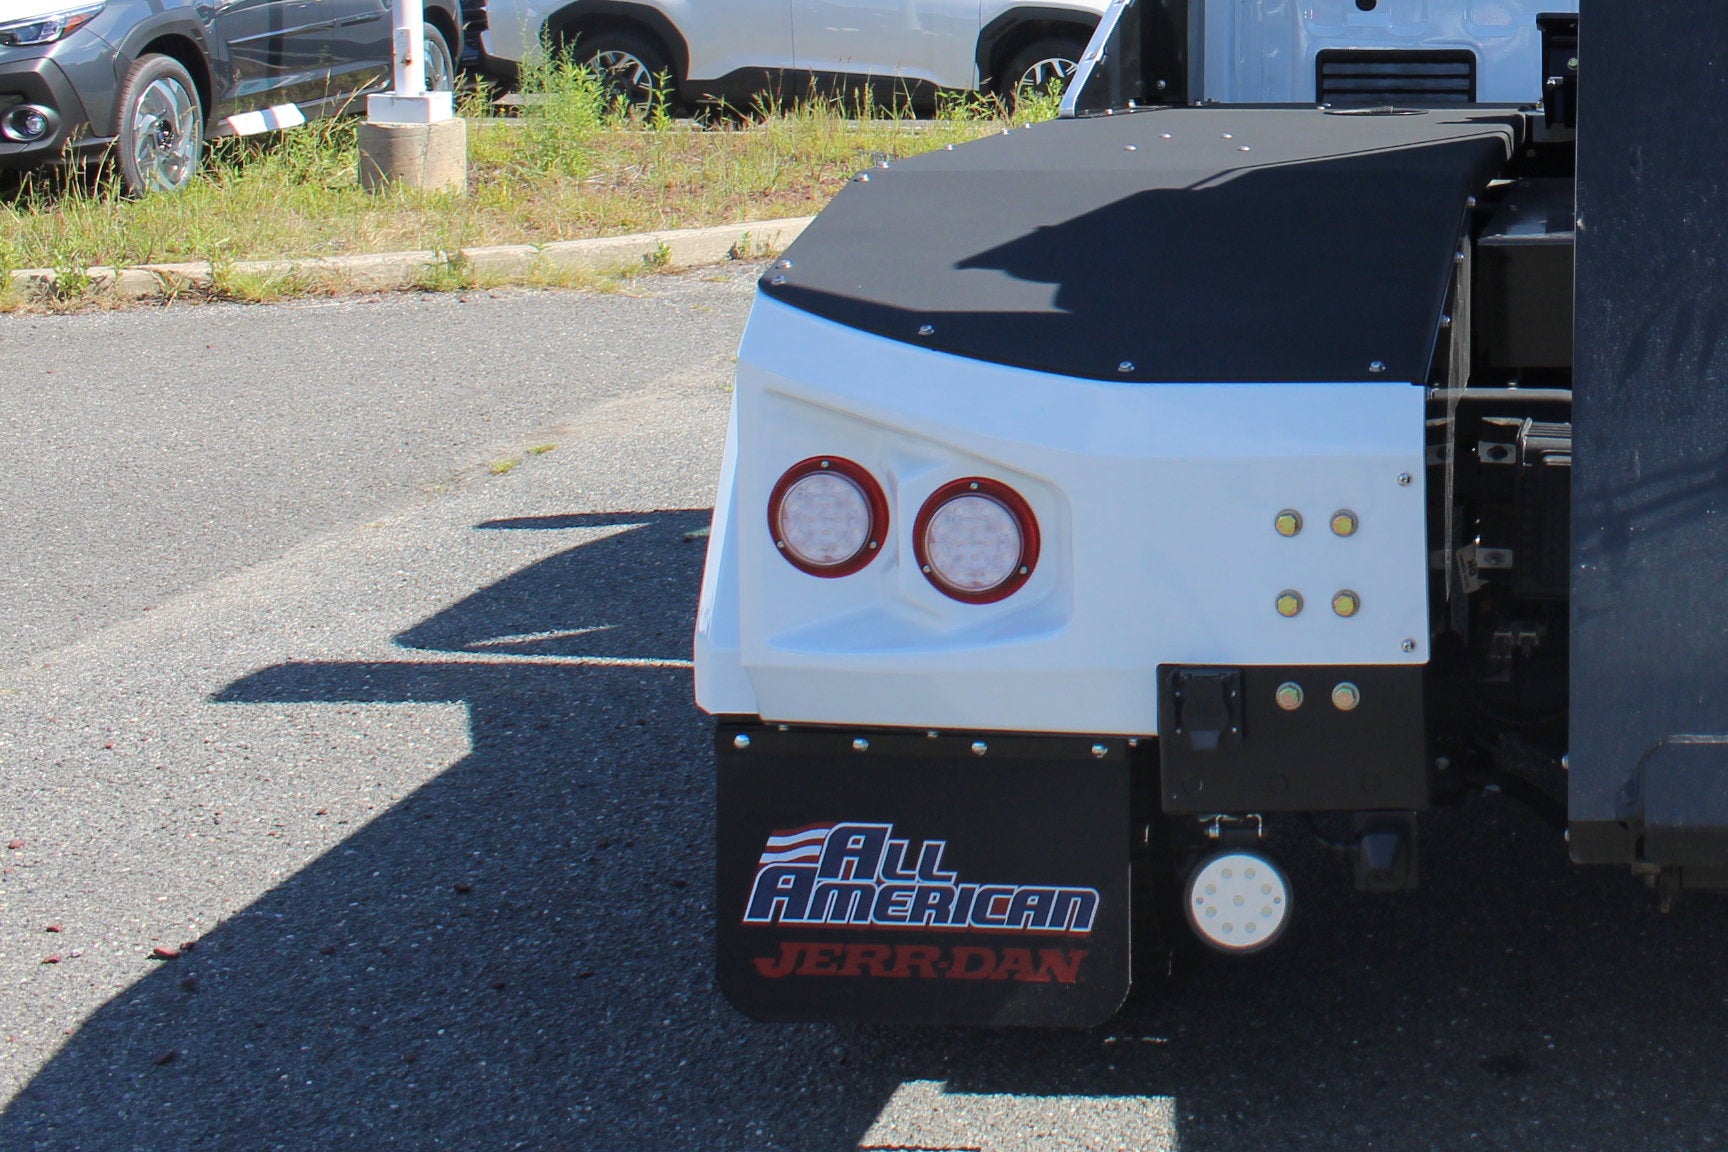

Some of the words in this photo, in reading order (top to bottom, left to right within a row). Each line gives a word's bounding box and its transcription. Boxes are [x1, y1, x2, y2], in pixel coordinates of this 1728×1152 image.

[818, 822, 957, 883] ALL
[743, 863, 1100, 932] AMERICAN
[753, 942, 1088, 983] JERR-DAN
